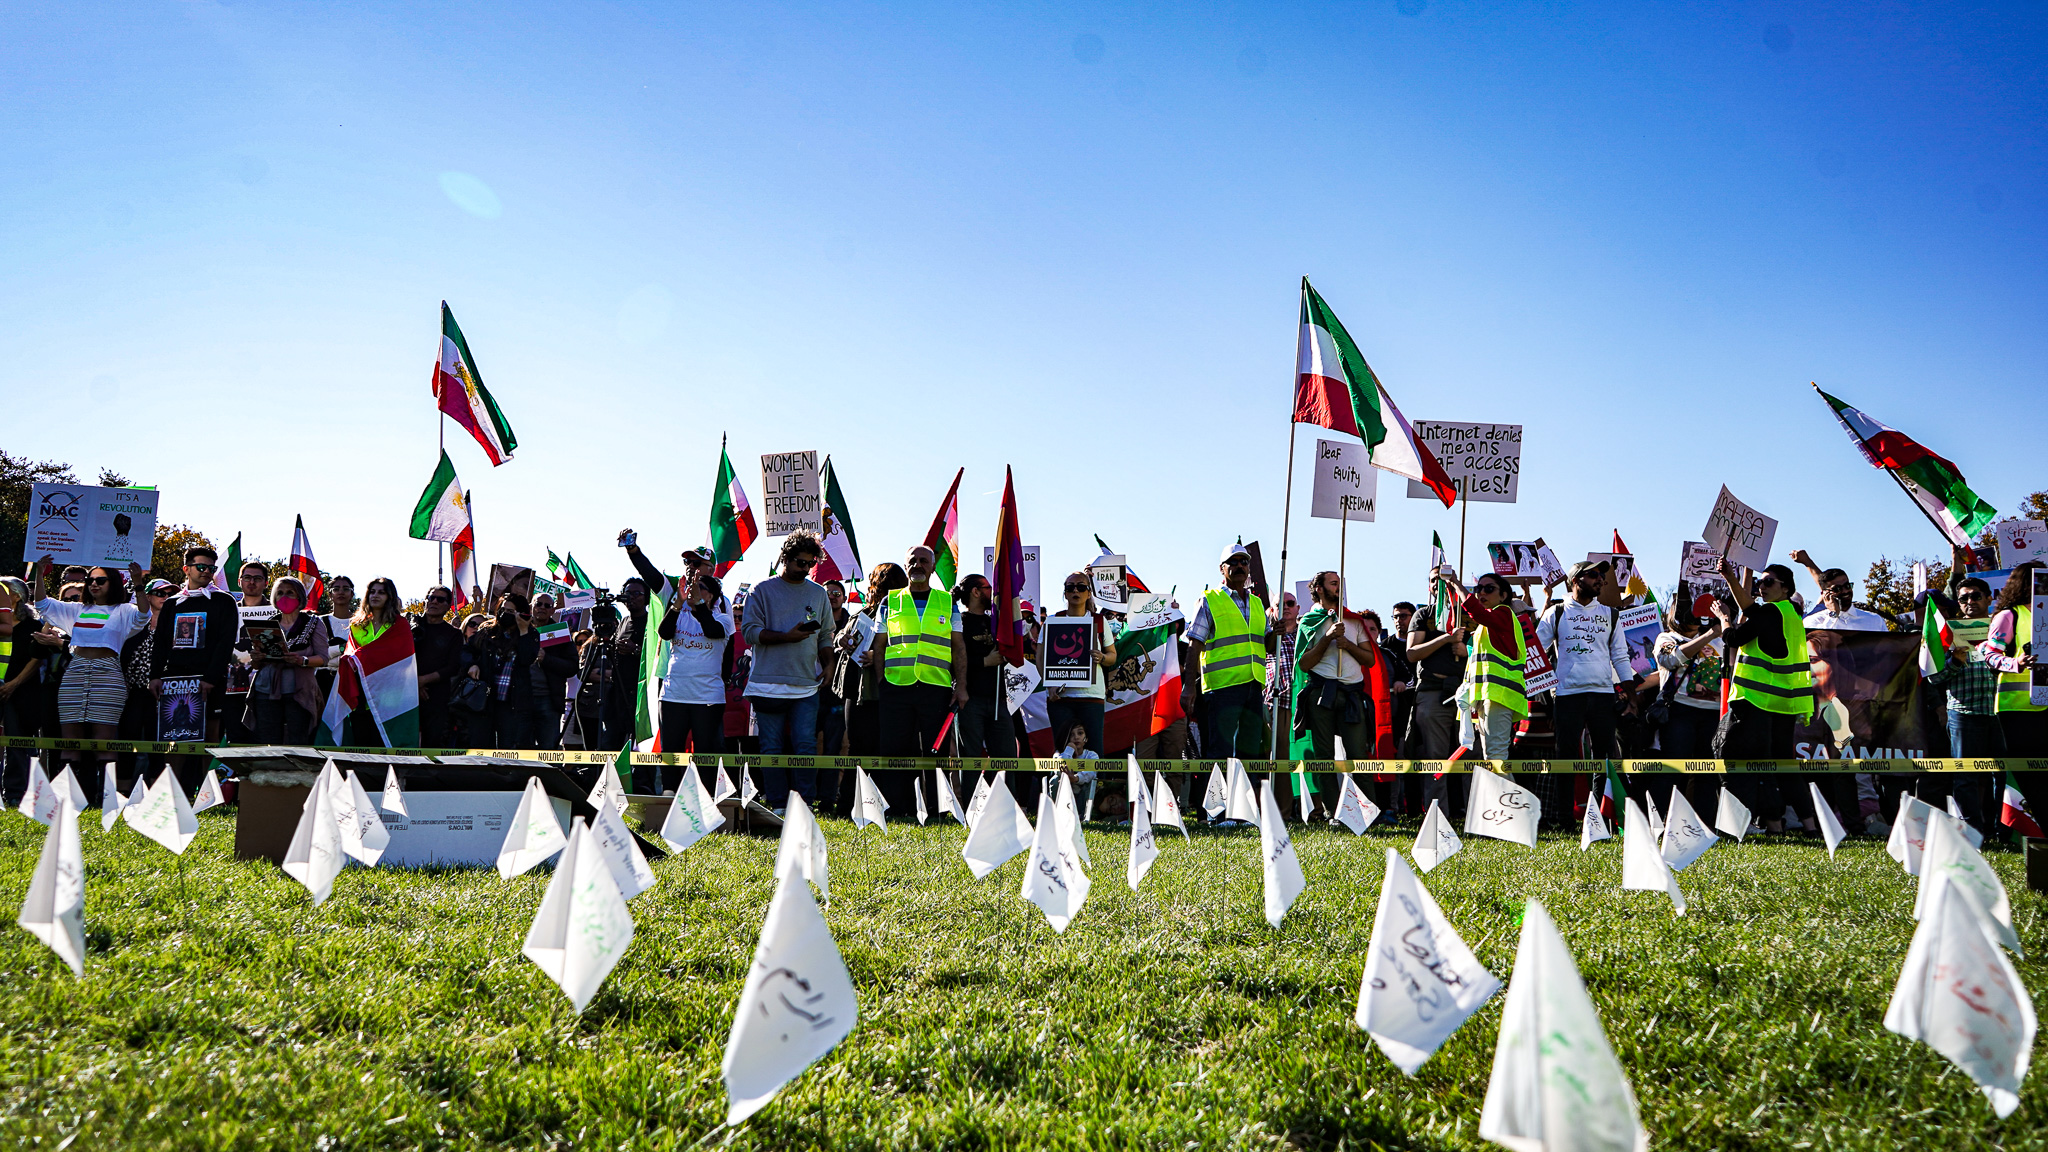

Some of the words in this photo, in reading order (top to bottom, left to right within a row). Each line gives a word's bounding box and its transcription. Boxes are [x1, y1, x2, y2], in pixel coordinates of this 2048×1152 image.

[1416, 422, 1480, 442] Internet
[1485, 425, 1522, 443] denies
[1441, 441, 1499, 455] means
[761, 452, 813, 473] WOMEN
[1464, 456, 1520, 474] access
[765, 474, 805, 494] LIFE
[1452, 474, 1510, 494] nies!
[133, 494, 139, 502] A
[100, 503, 152, 514] REVOLUTION
[765, 494, 820, 515] FREEDOM
[40, 504, 79, 517] NIAC
[1717, 492, 1764, 536] MAHSA
[766, 518, 819, 532] #MahsaAmini
[1711, 507, 1762, 552] AMINI
[1096, 572, 1114, 581] IRAN
[1620, 607, 1656, 620] ICTATORSHIP
[1621, 619, 1635, 628] ND
[1636, 614, 1657, 624] NOW
[1053, 626, 1084, 658] زن
[1048, 670, 1068, 678] MAHSA
[1070, 670, 1087, 678] AMINI
[1528, 676, 1544, 685] THEM
[152, 743, 178, 752] CAUTION
[538, 752, 564, 761] CAUTION
[637, 754, 663, 763] CAUTION
[735, 756, 761, 765] CAUTION
[788, 757, 814, 766] CUIDADO
[835, 757, 861, 766] CAUTION
[889, 759, 916, 768] CUIDADO
[936, 759, 963, 768] CAUTION
[991, 760, 1018, 768] CUIDADO
[1039, 761, 1066, 770] CAUTION
[1095, 761, 1122, 770] CUIDADO
[1144, 761, 1171, 770] CAUTION
[1250, 762, 1277, 770] CAUTION
[1685, 762, 1715, 770] CAUTION
[1746, 762, 1776, 770] CUIDADO
[1800, 761, 1829, 770] CAUTION
[1860, 761, 1890, 770] CUIDADO
[1912, 761, 1943, 770] CAUTION
[1974, 760, 2004, 769] CUIDADO
[2028, 761, 2048, 769] UTION
[1306, 762, 1334, 771] CUIDADO
[1356, 762, 1384, 771] CAUTION
[1414, 763, 1442, 771] CUIDADO
[1464, 763, 1492, 771] CAUTION
[1522, 762, 1551, 771] CUIDADO
[1573, 762, 1602, 771] CAUTION
[1633, 762, 1662, 771] CUIDADO
